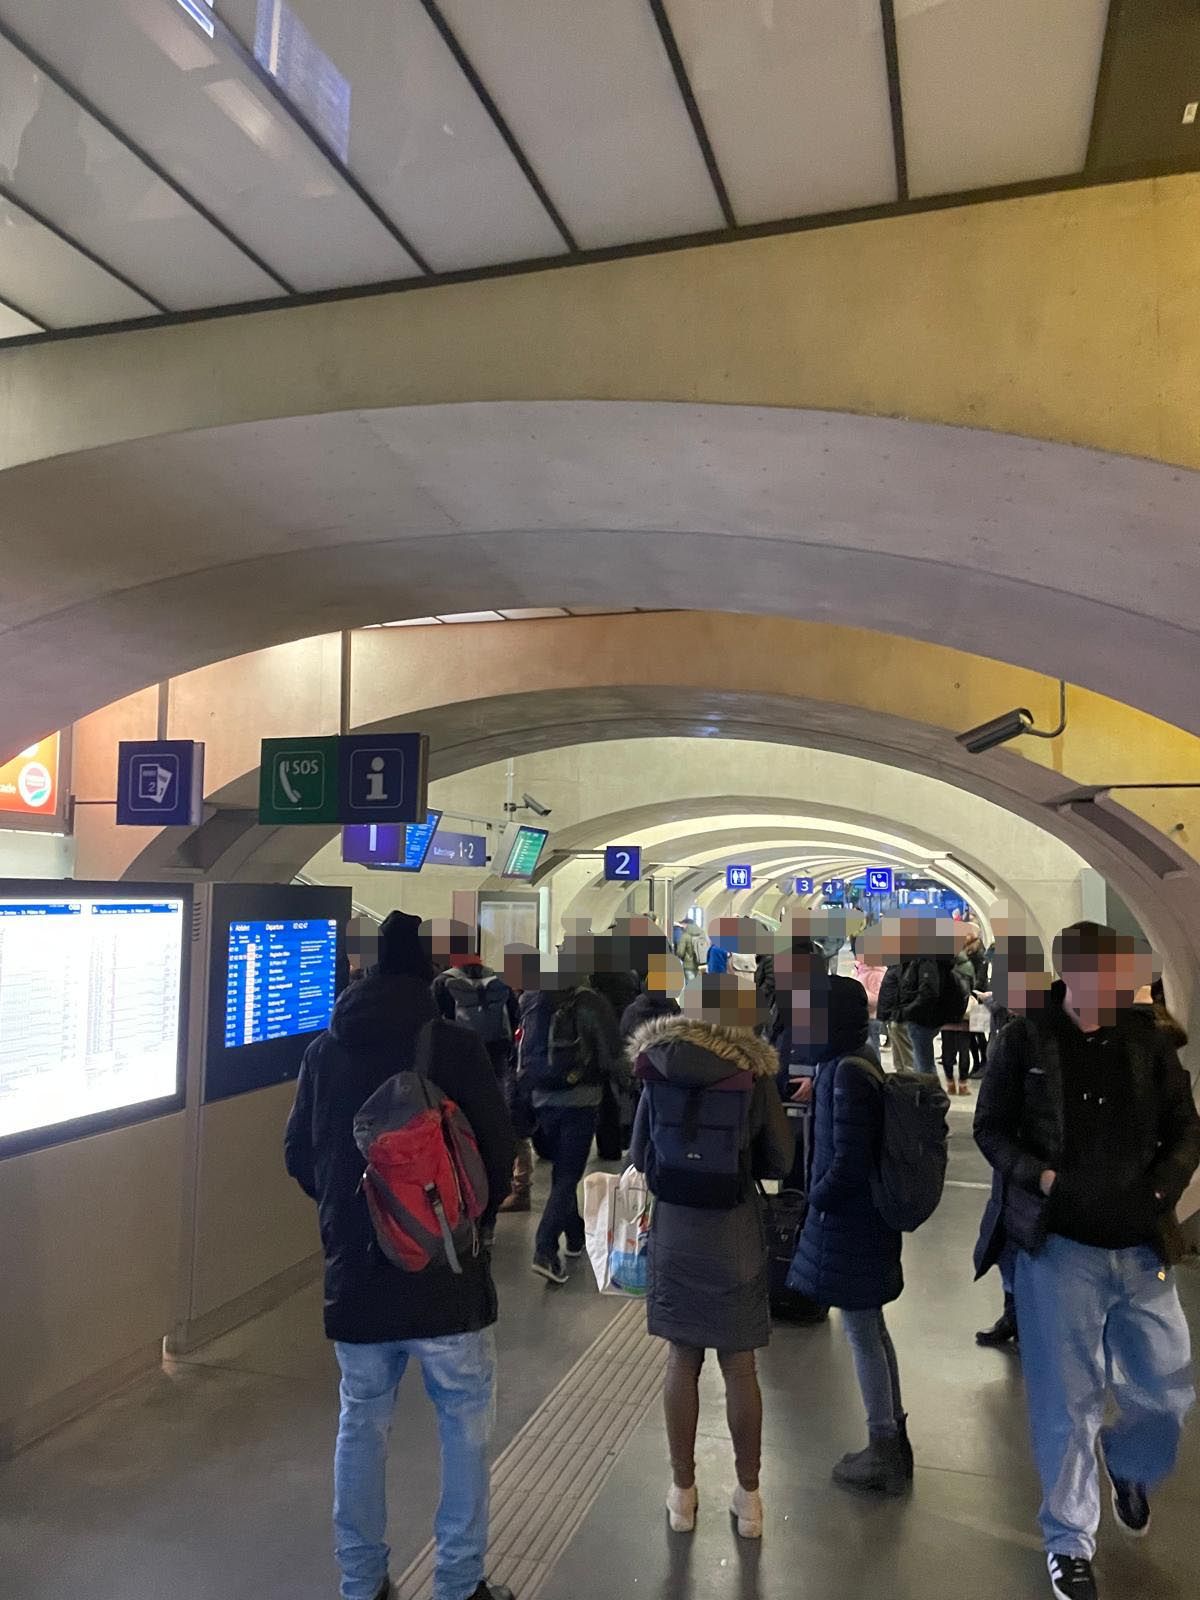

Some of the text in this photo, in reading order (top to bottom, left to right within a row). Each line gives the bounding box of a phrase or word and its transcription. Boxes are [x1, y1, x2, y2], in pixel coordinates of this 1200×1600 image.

[293, 759, 319, 775] SOS
[614, 852, 631, 875] 2
[800, 880, 809, 892] 3
[825, 883, 833, 894] 4
